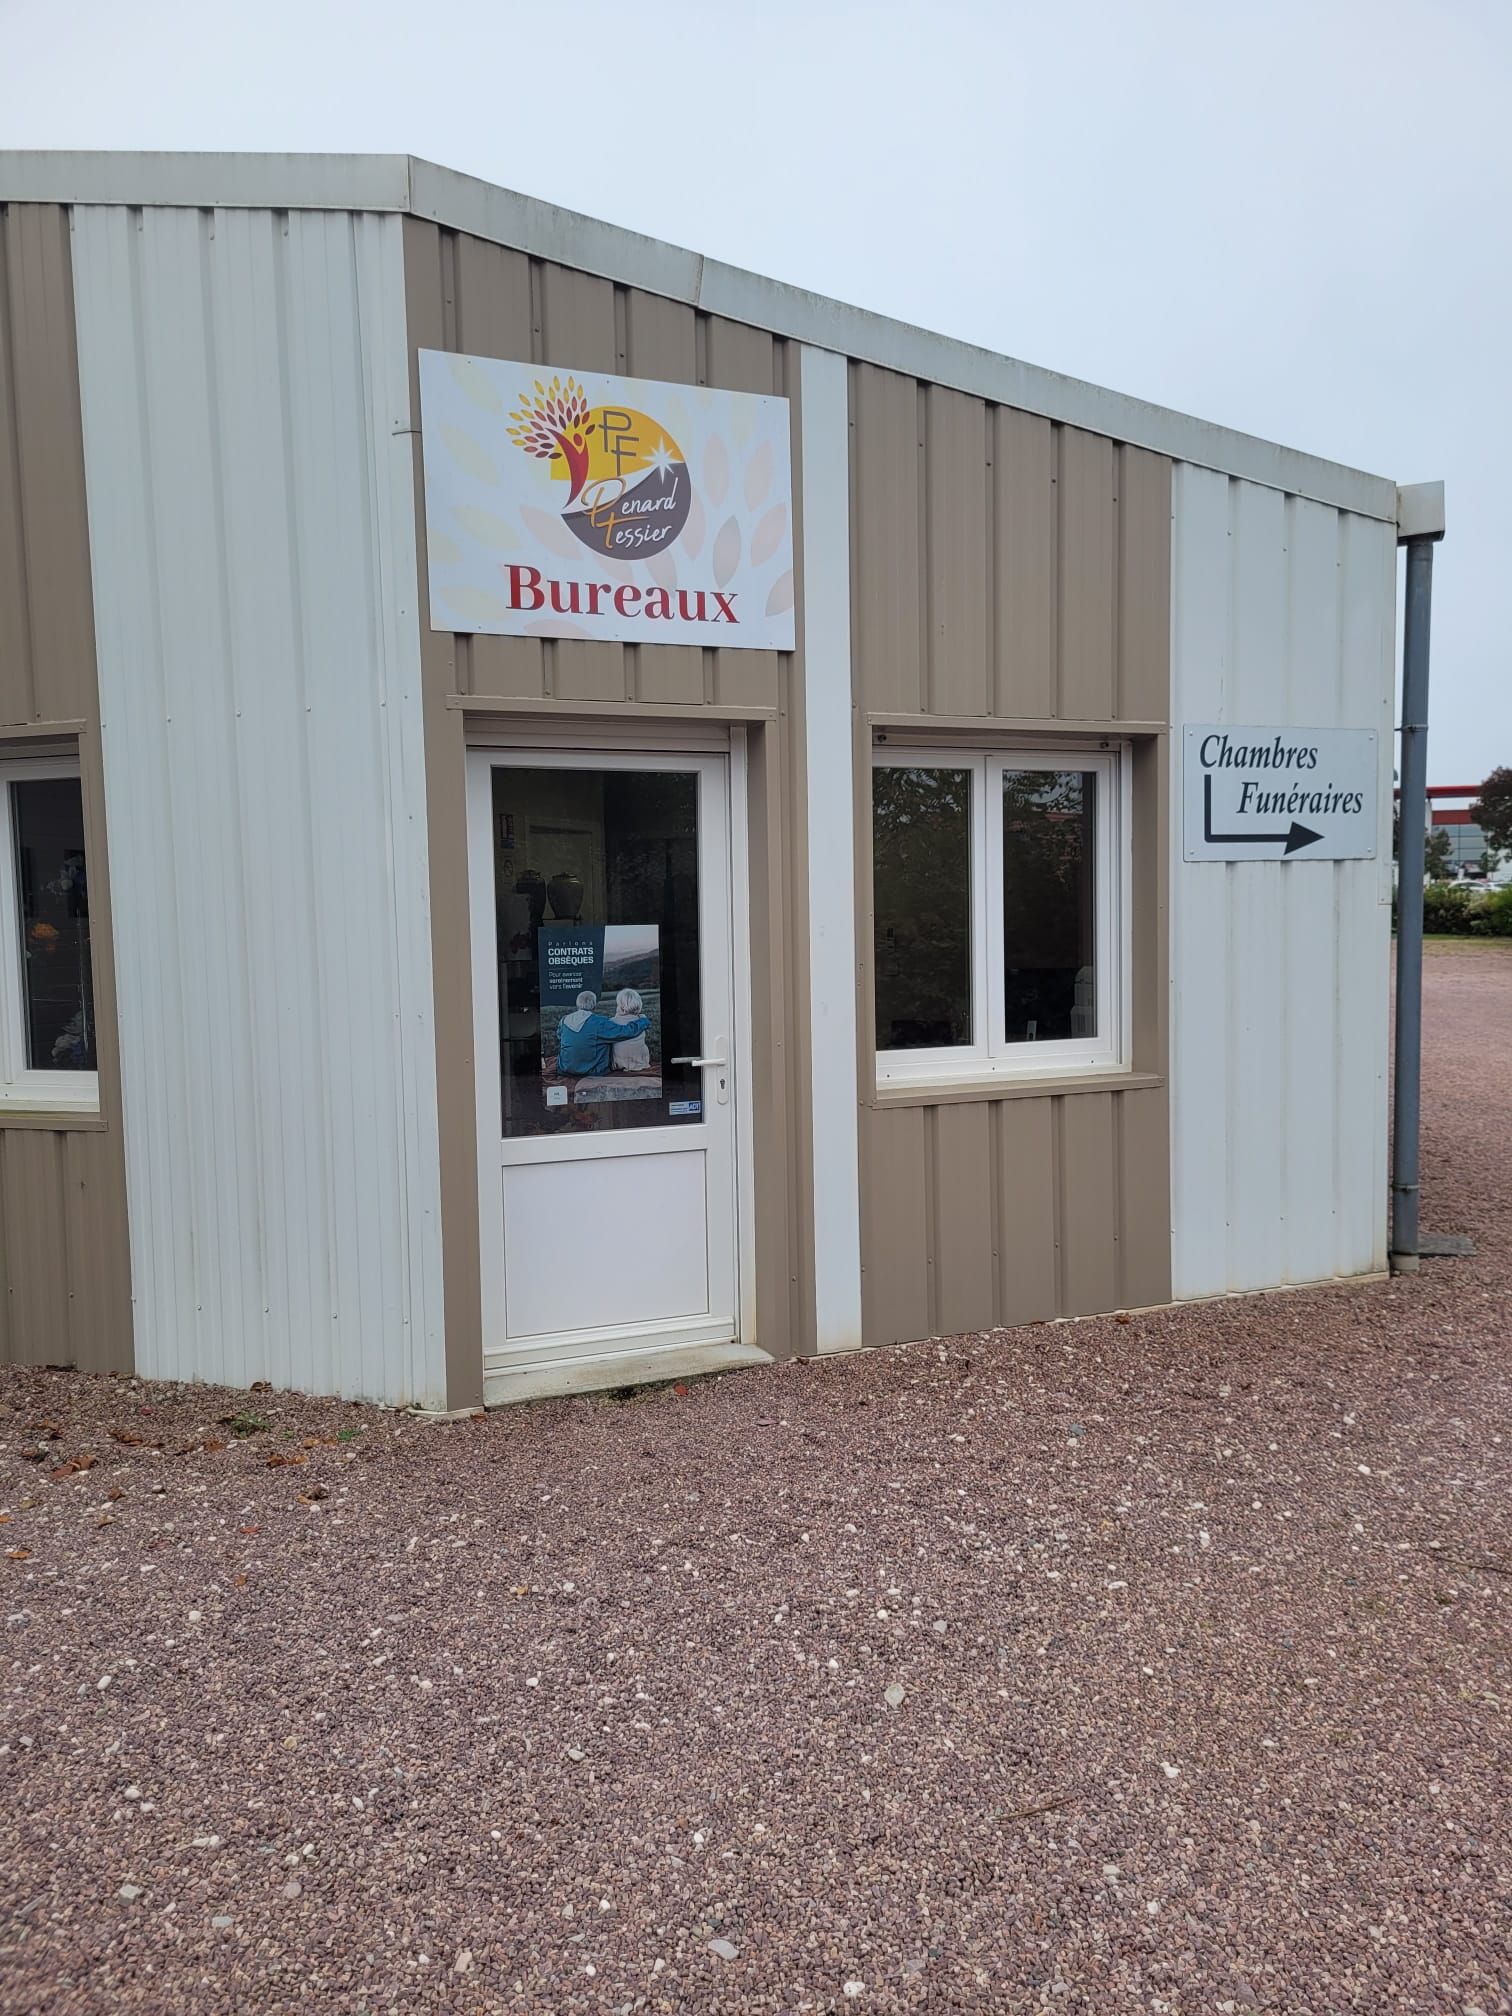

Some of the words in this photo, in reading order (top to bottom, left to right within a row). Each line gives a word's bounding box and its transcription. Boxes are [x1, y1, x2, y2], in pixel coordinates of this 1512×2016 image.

[581, 477, 679, 528] Penard
[504, 564, 740, 624] Bureaux
[1199, 734, 1318, 769] Chambres
[1235, 781, 1364, 814] Funéraires
[548, 947, 594, 956] CONTRATS
